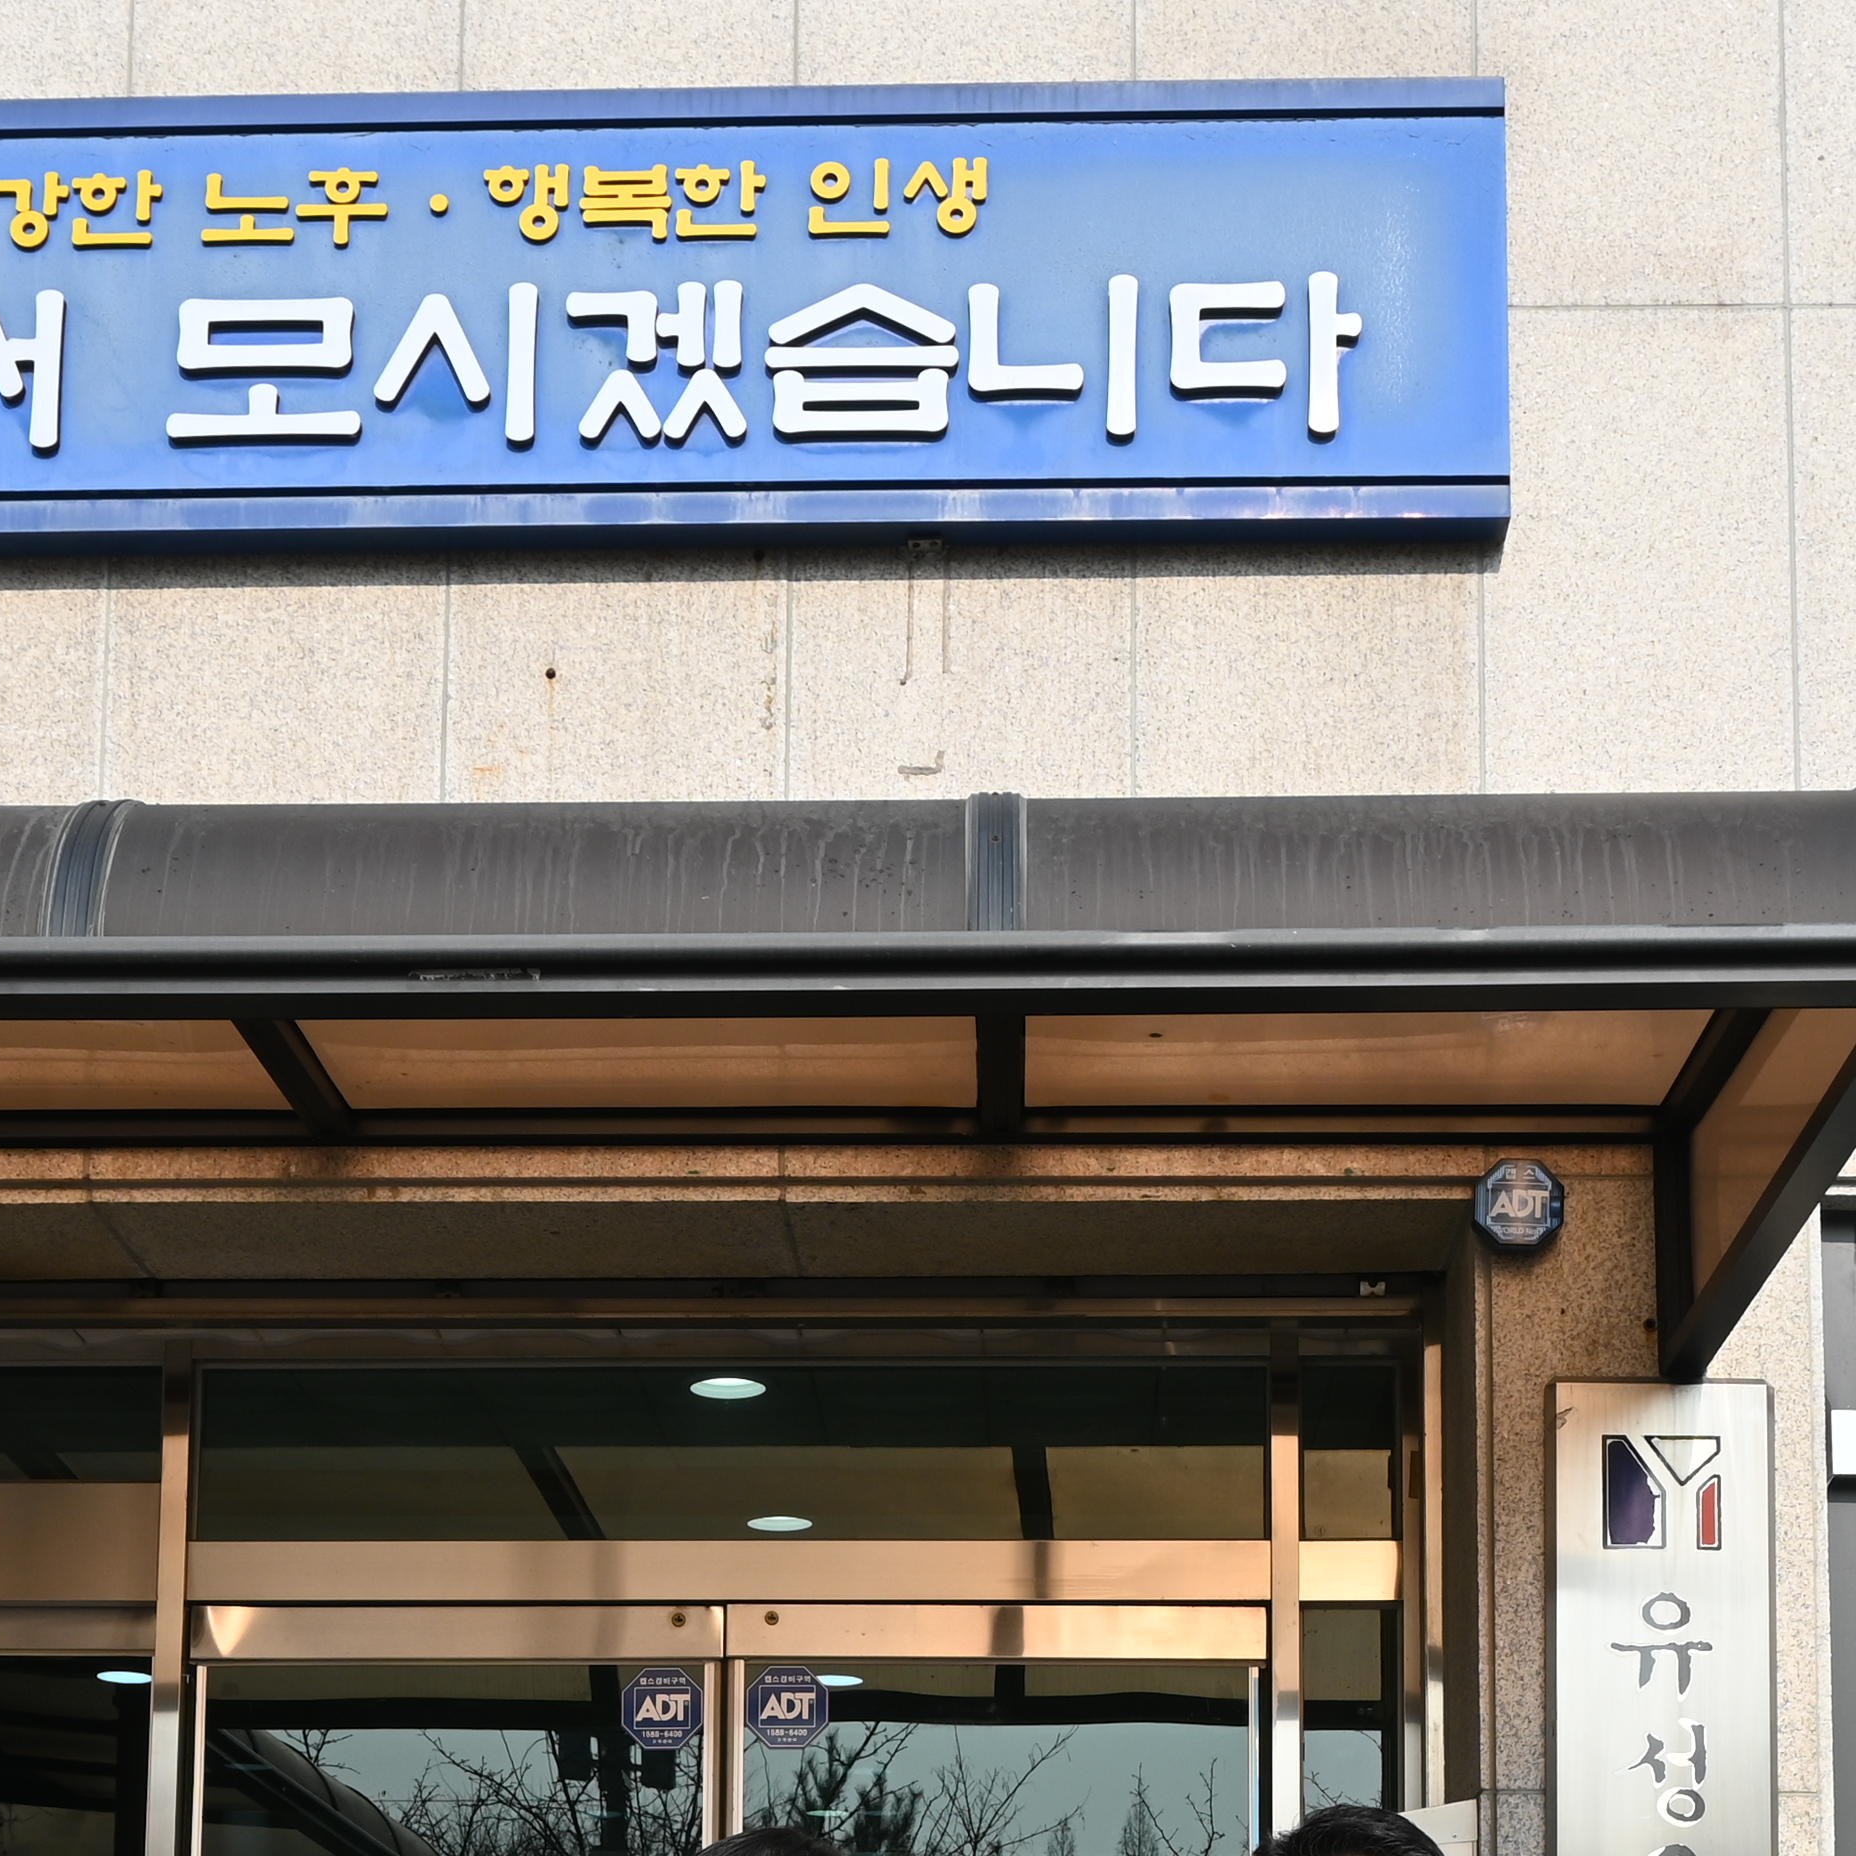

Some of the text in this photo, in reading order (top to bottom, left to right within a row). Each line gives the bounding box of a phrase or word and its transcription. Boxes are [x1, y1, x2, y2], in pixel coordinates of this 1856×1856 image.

[202, 169, 390, 246] 노후
[485, 163, 769, 240] 행복한
[810, 157, 992, 236] 인생
[165, 270, 1361, 448] 모시겠습니다
[1489, 1189, 1549, 1218] ADT
[635, 1693, 691, 1721] ADT
[760, 1692, 816, 1720] ADT
